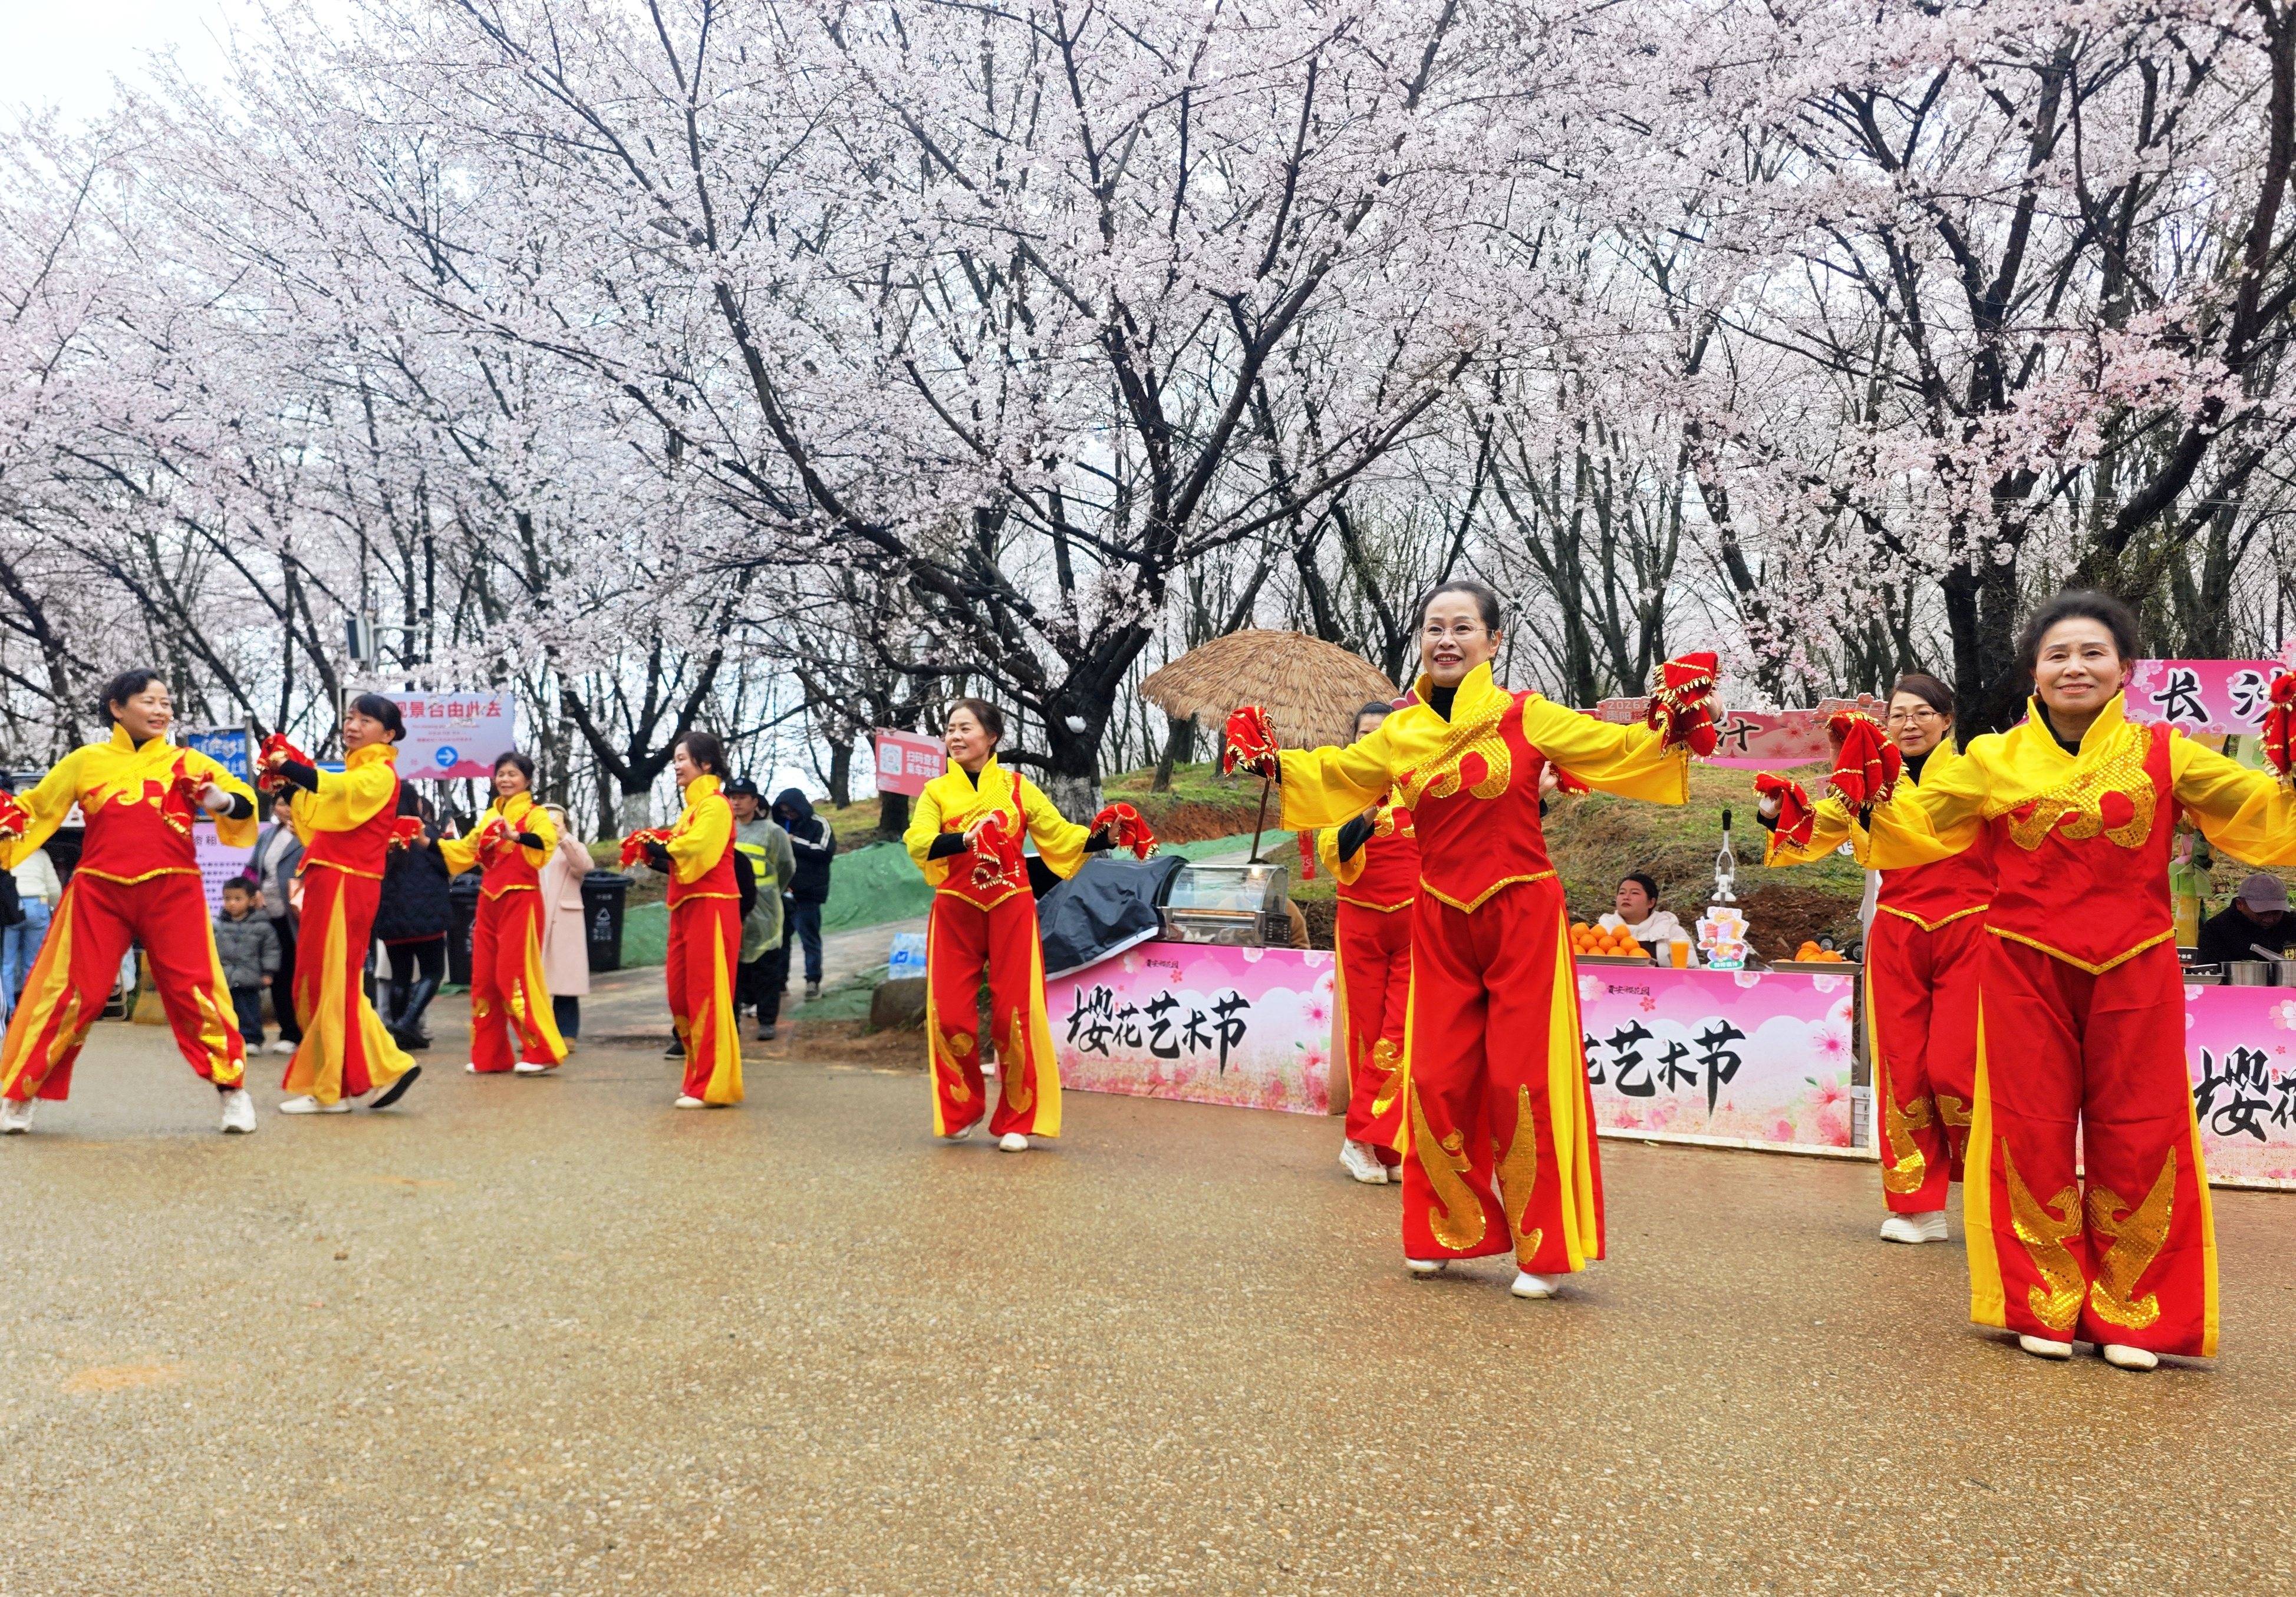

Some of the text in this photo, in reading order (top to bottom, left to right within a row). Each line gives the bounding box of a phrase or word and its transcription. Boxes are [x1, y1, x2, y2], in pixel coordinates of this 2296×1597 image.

[1068, 985, 1251, 1078] 樱花艺术节
